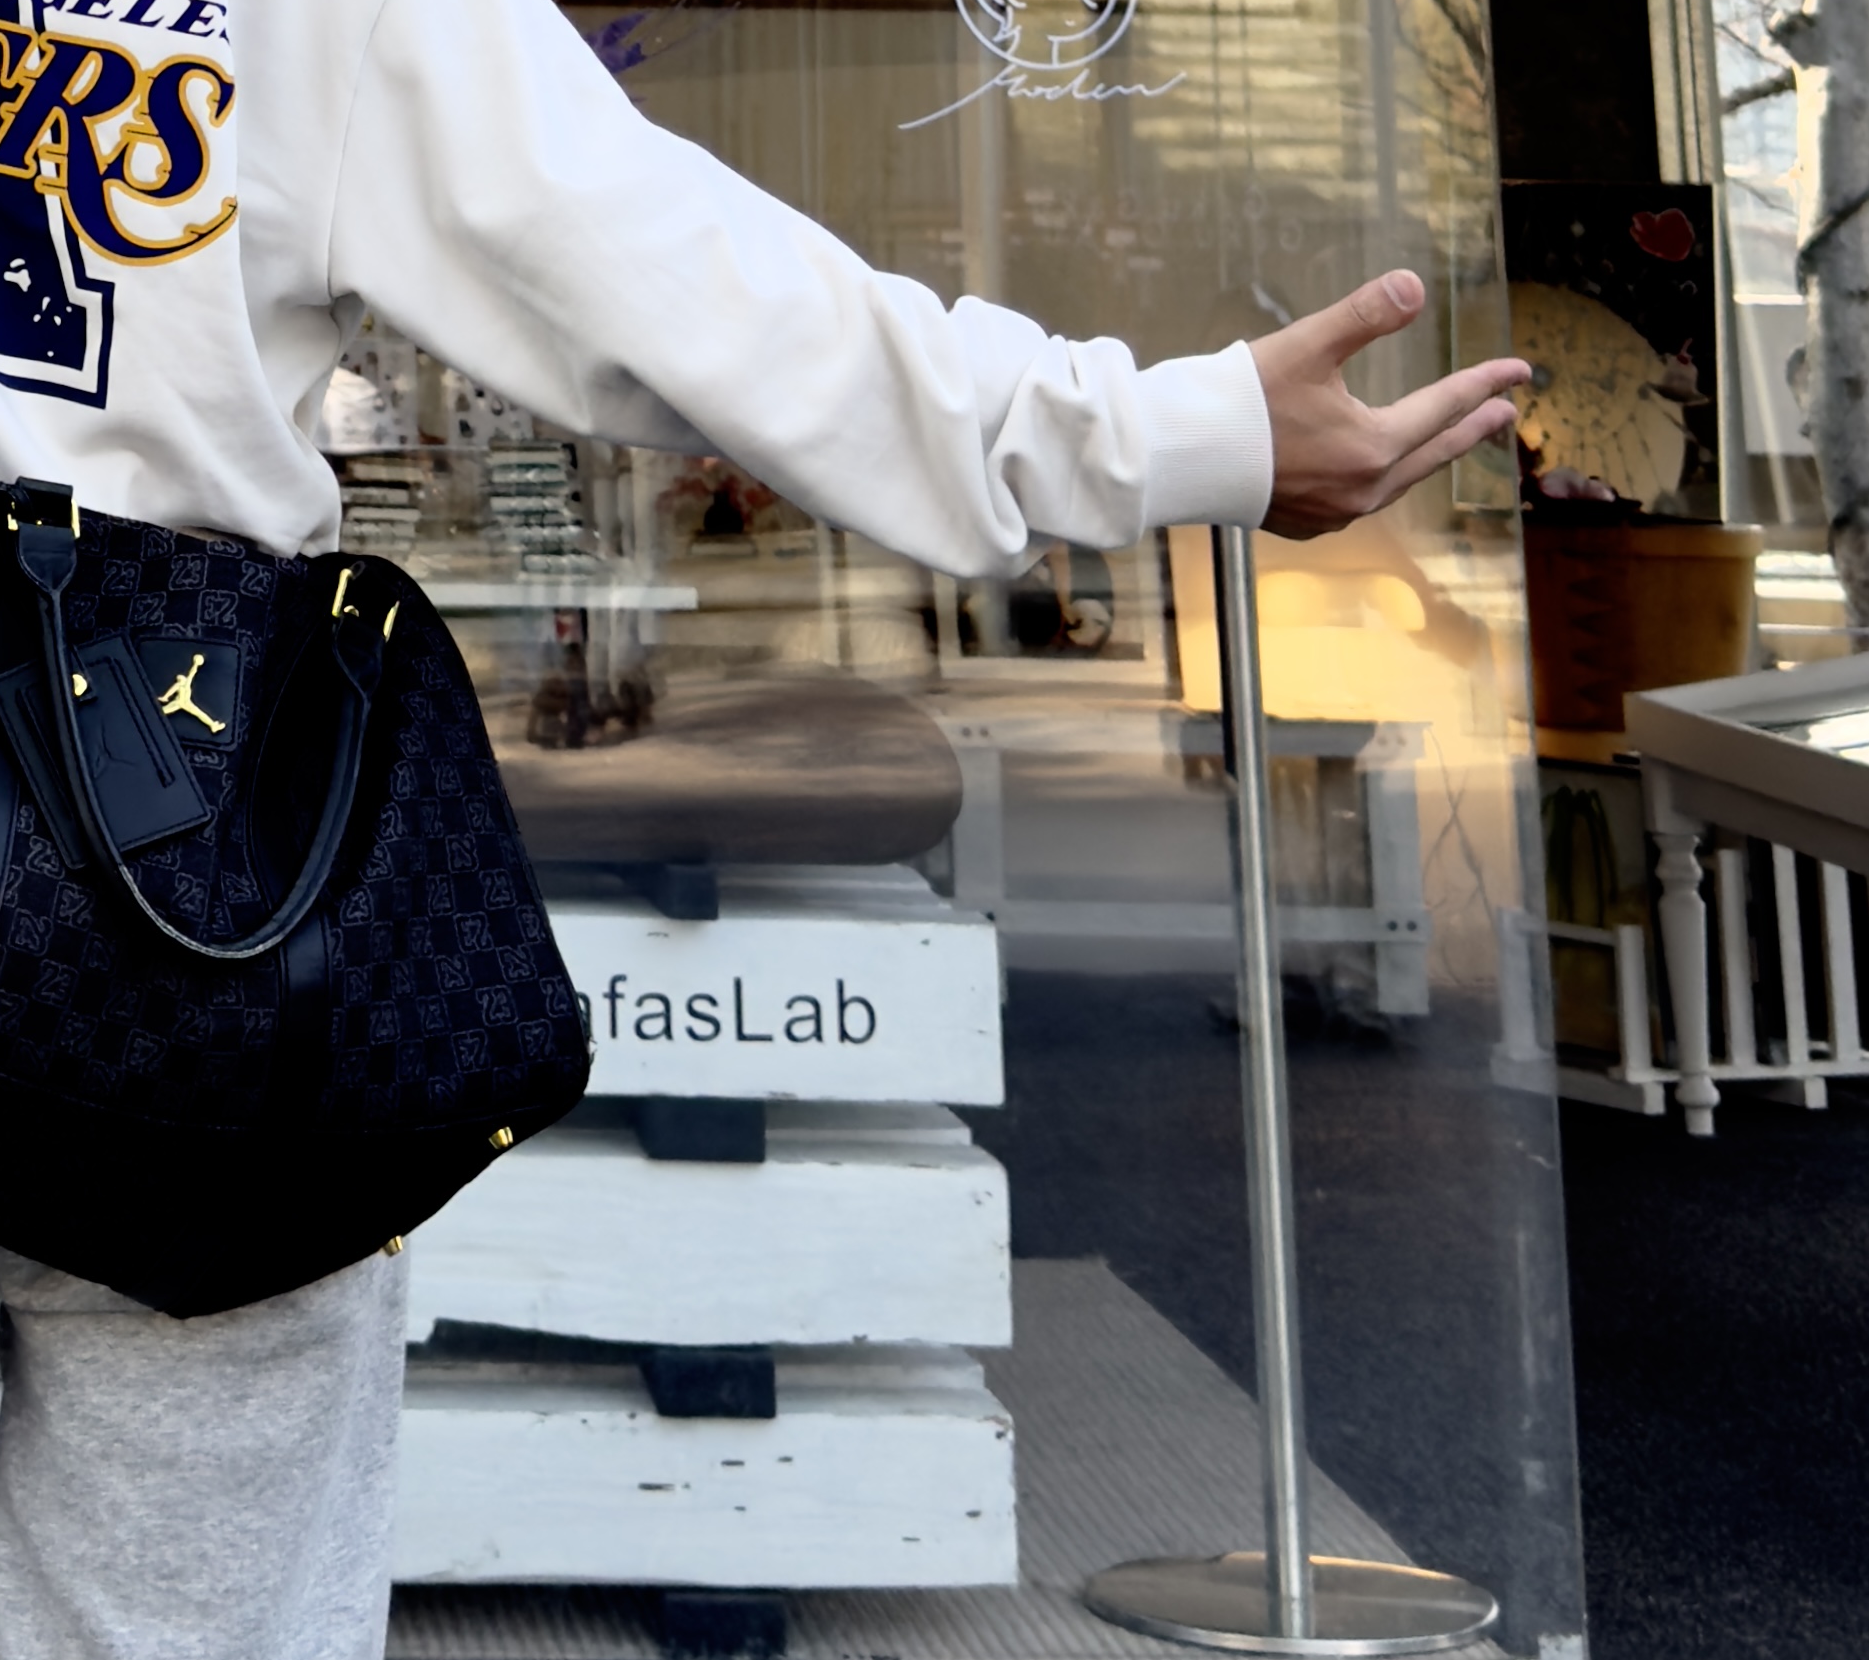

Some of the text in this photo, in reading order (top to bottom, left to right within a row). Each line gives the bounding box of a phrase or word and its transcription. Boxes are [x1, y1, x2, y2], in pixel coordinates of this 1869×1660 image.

[102, 559, 142, 596] 23
[169, 554, 208, 591] 23
[240, 560, 279, 603] 23
[431, 758, 463, 797] 23
[26, 835, 65, 880] 23
[171, 872, 210, 923] 23
[340, 885, 375, 927] 23
[427, 874, 456, 916] 23
[480, 869, 517, 910] 23
[33, 959, 79, 1008] 23
[172, 1003, 213, 1047] 23
[369, 1000, 401, 1045] 23
[416, 995, 452, 1038] 23
[476, 985, 519, 1027] 23
[576, 973, 876, 1045] fasLab
